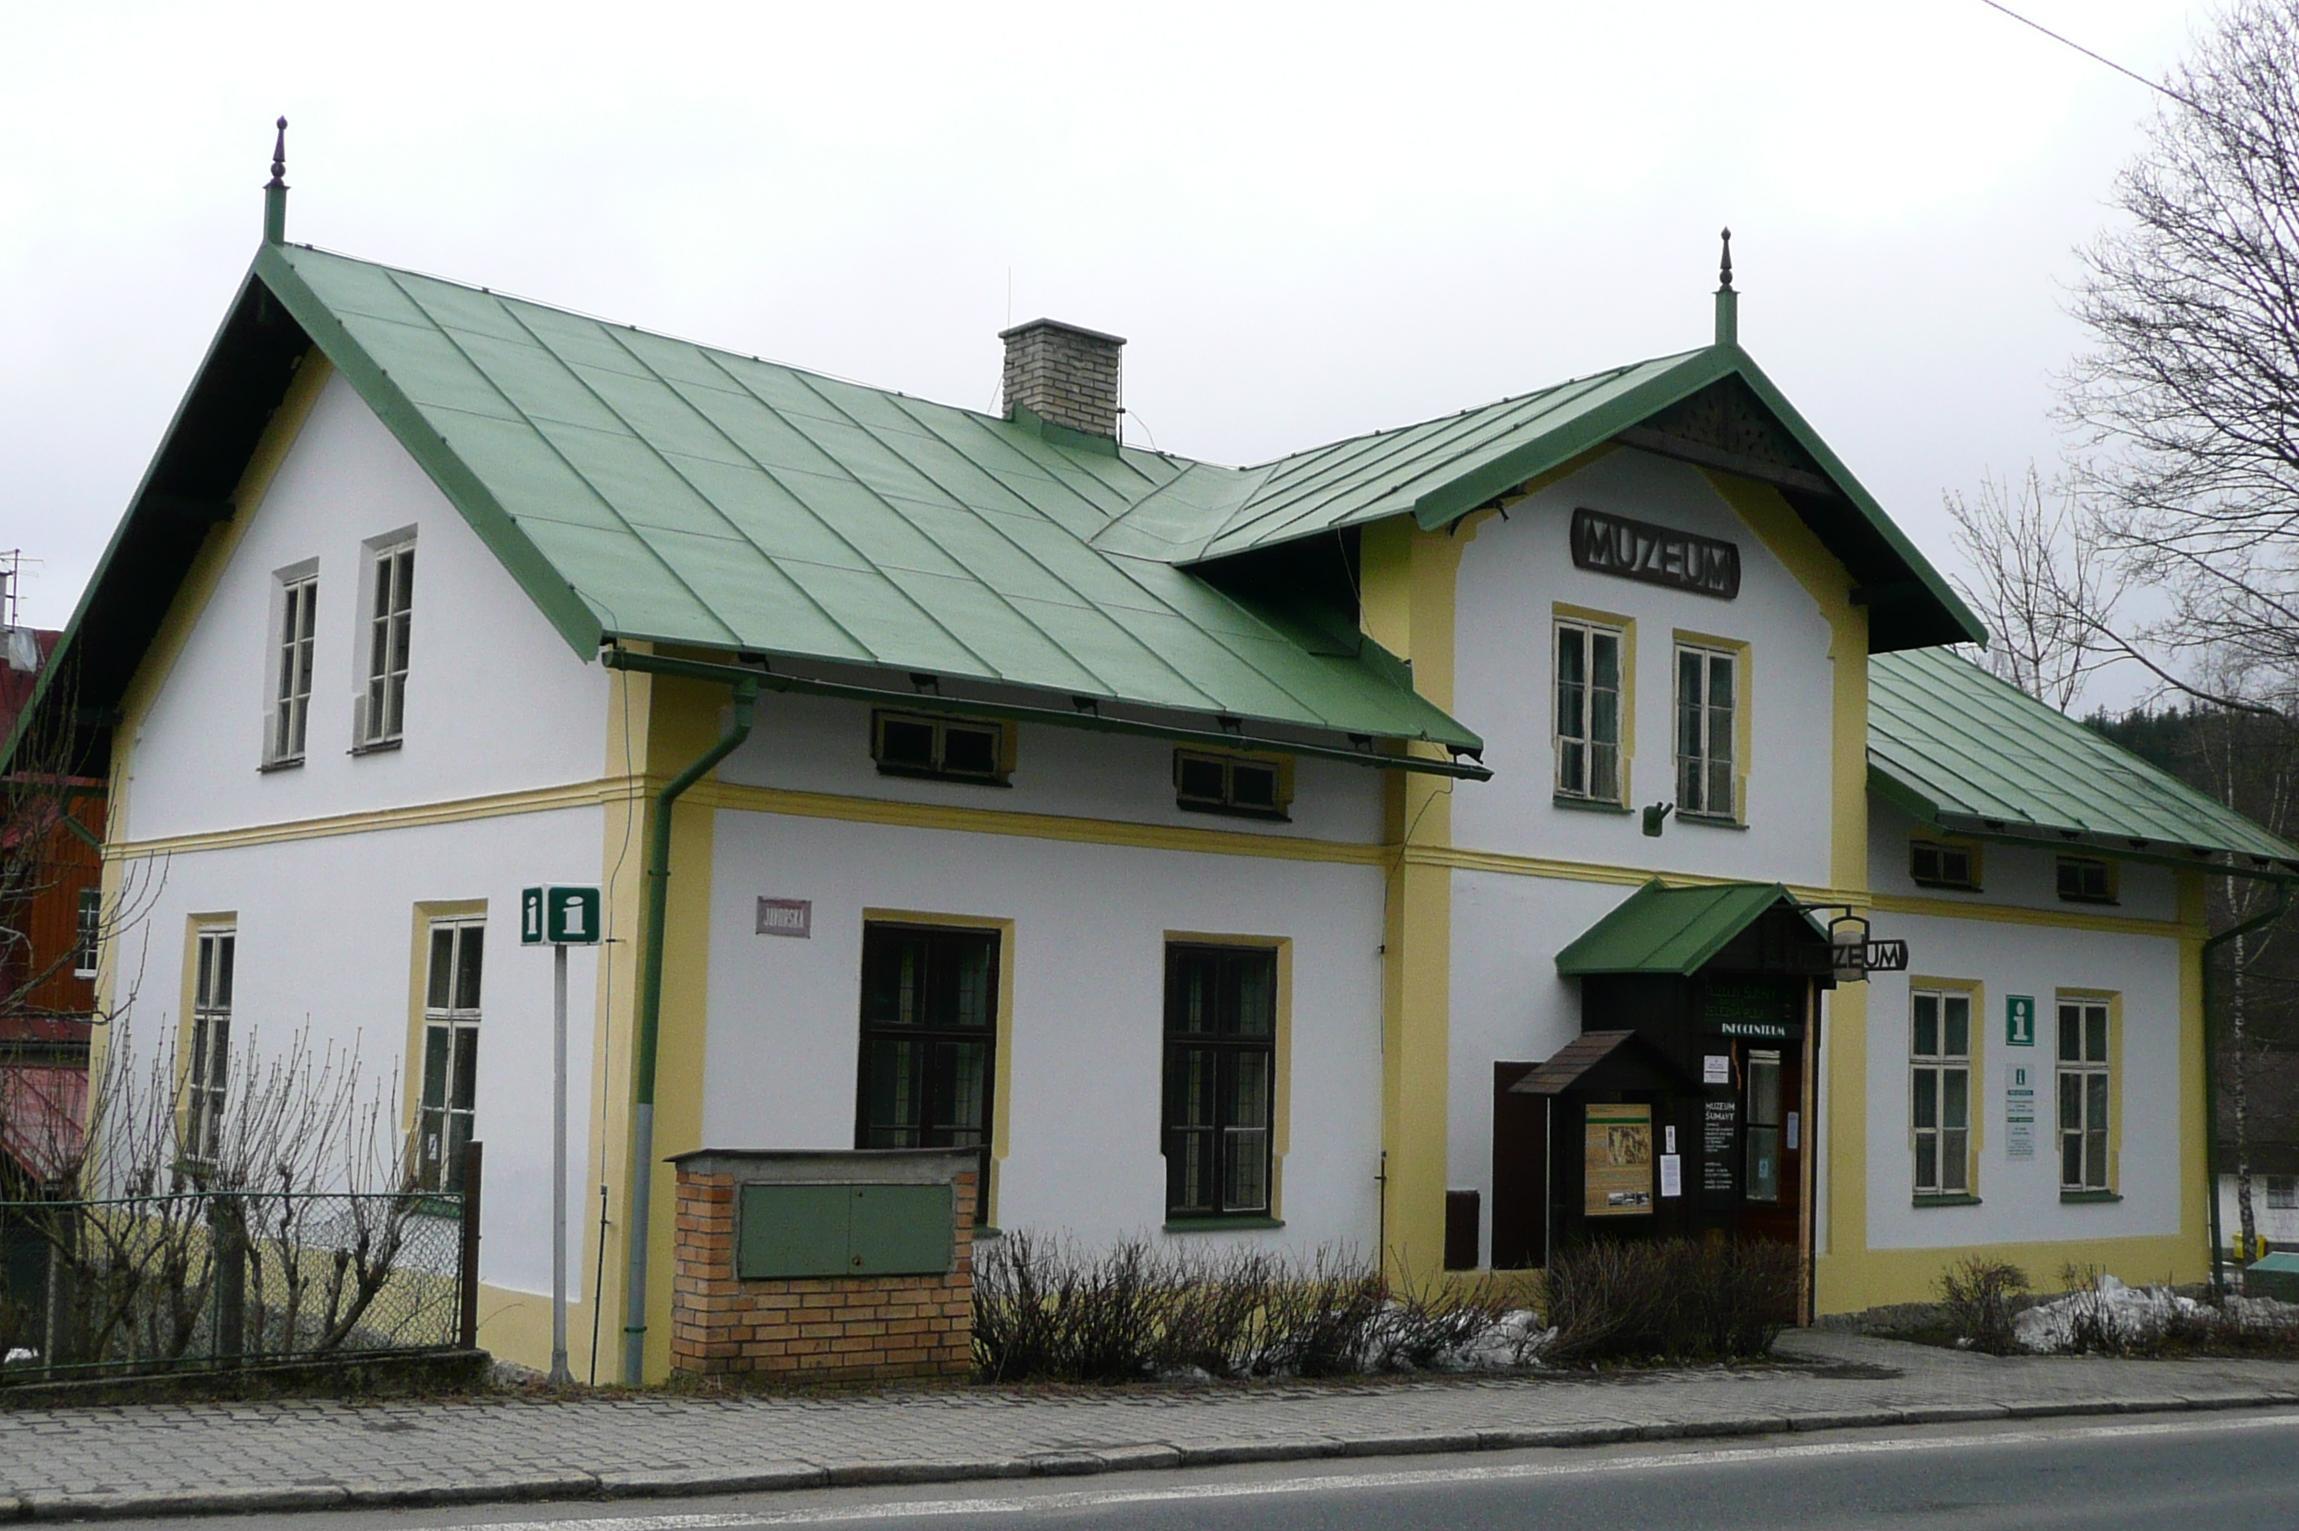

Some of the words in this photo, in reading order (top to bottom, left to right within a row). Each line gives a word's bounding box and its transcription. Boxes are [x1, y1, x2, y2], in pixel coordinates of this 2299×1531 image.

[1581, 517, 1732, 592] MUZEUM
[1832, 943, 1902, 970] ZEUM
[1721, 1022, 1786, 1037] INFOCENTRUM
[1705, 1102, 1735, 1111] MUZEUM
